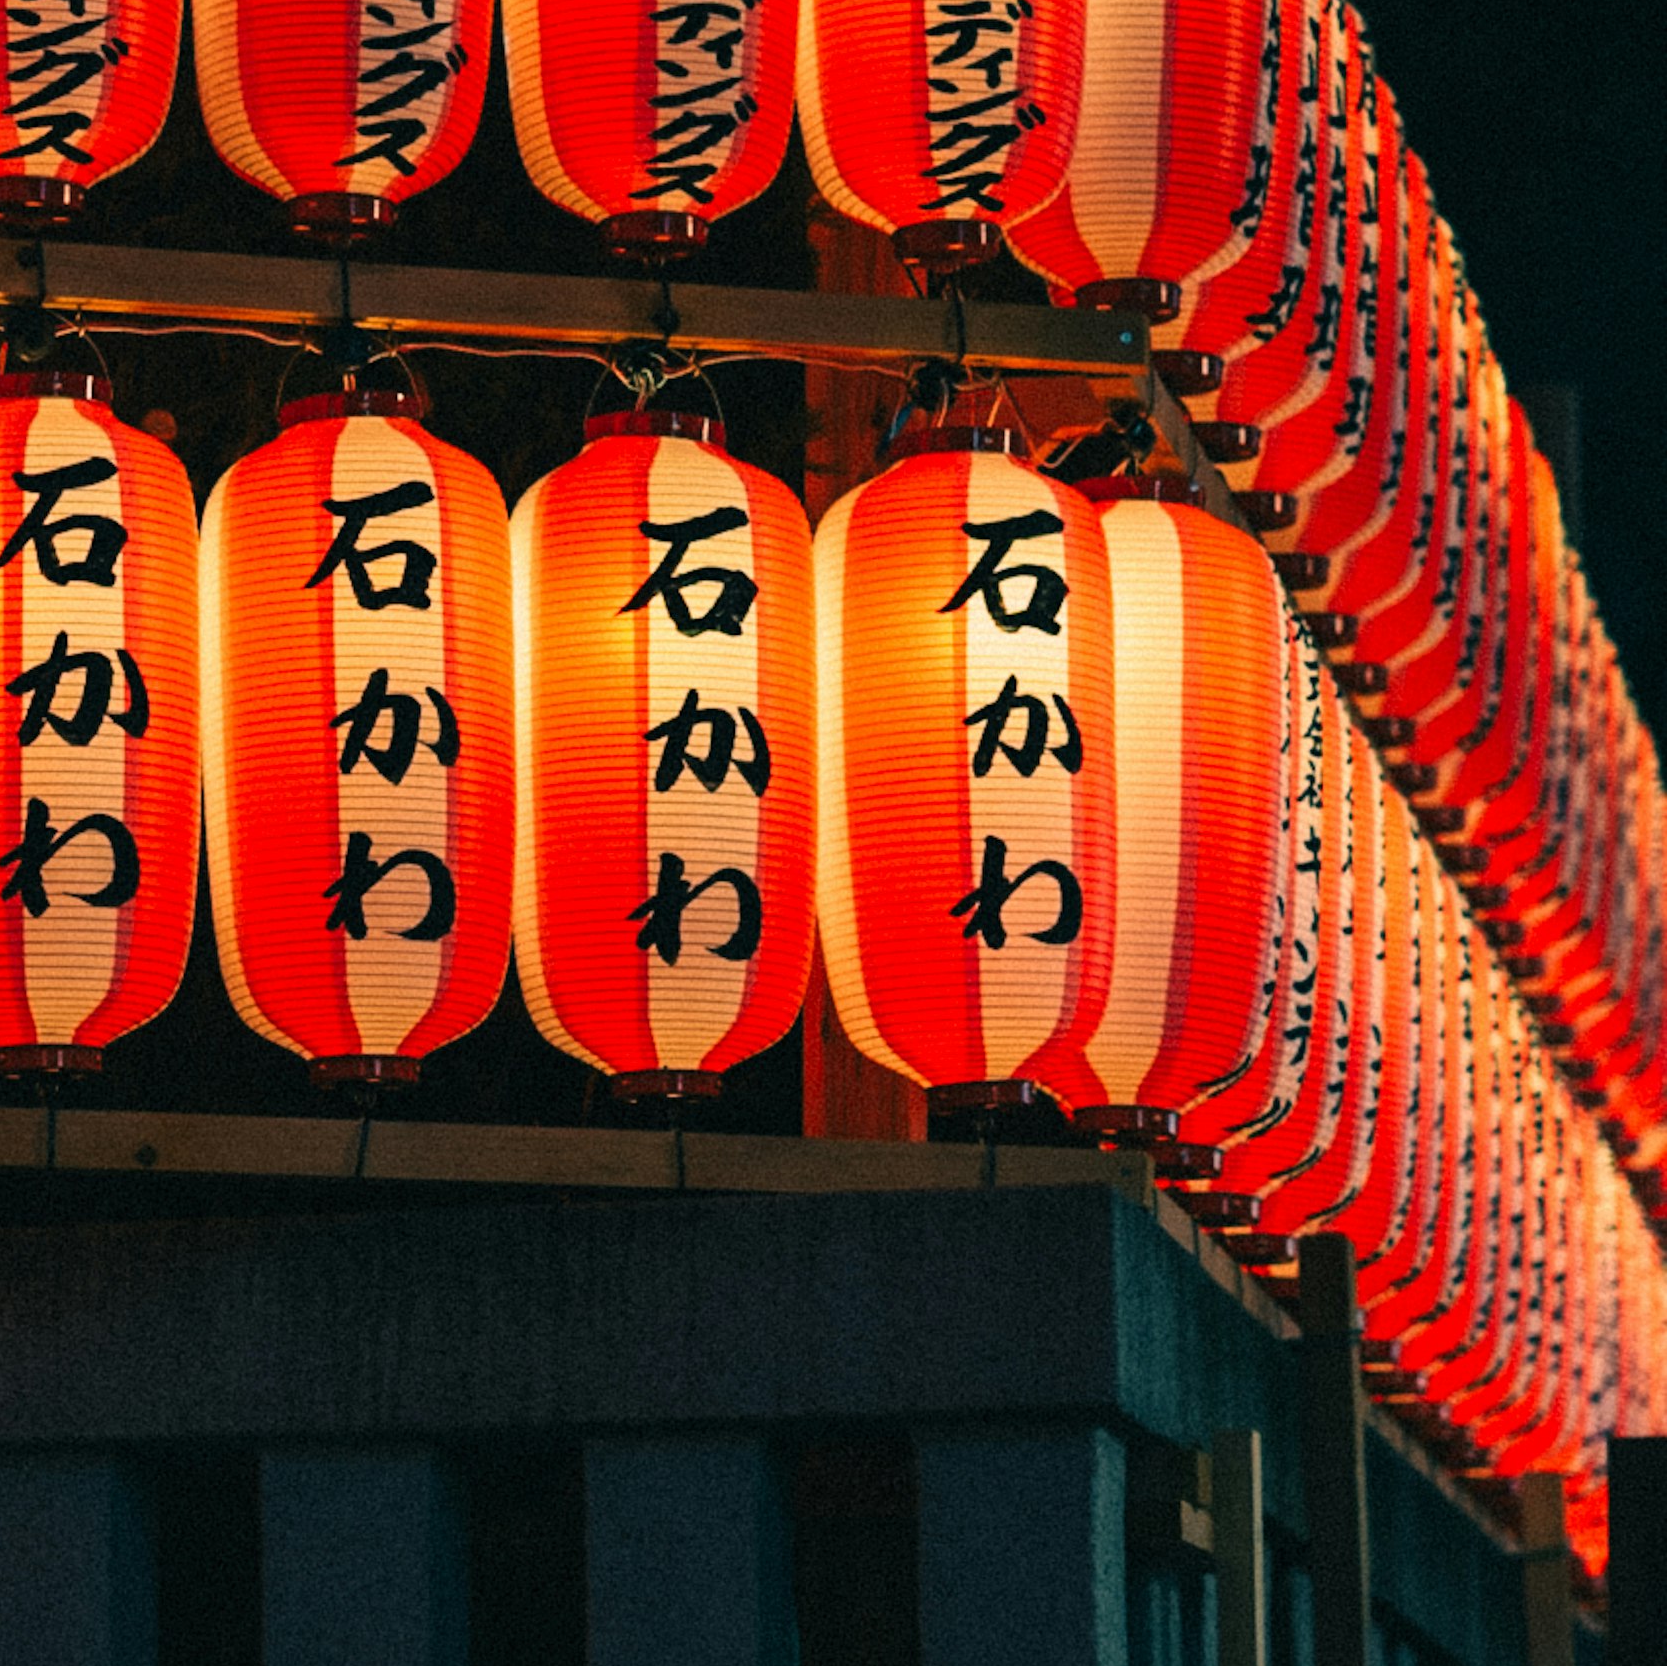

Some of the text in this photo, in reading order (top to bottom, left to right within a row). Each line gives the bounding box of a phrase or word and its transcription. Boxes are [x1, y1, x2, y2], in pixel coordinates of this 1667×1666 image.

[305, 480, 460, 941] 石かわ
[618, 506, 771, 966] 石かわ
[938, 510, 1084, 950] 石かわ
